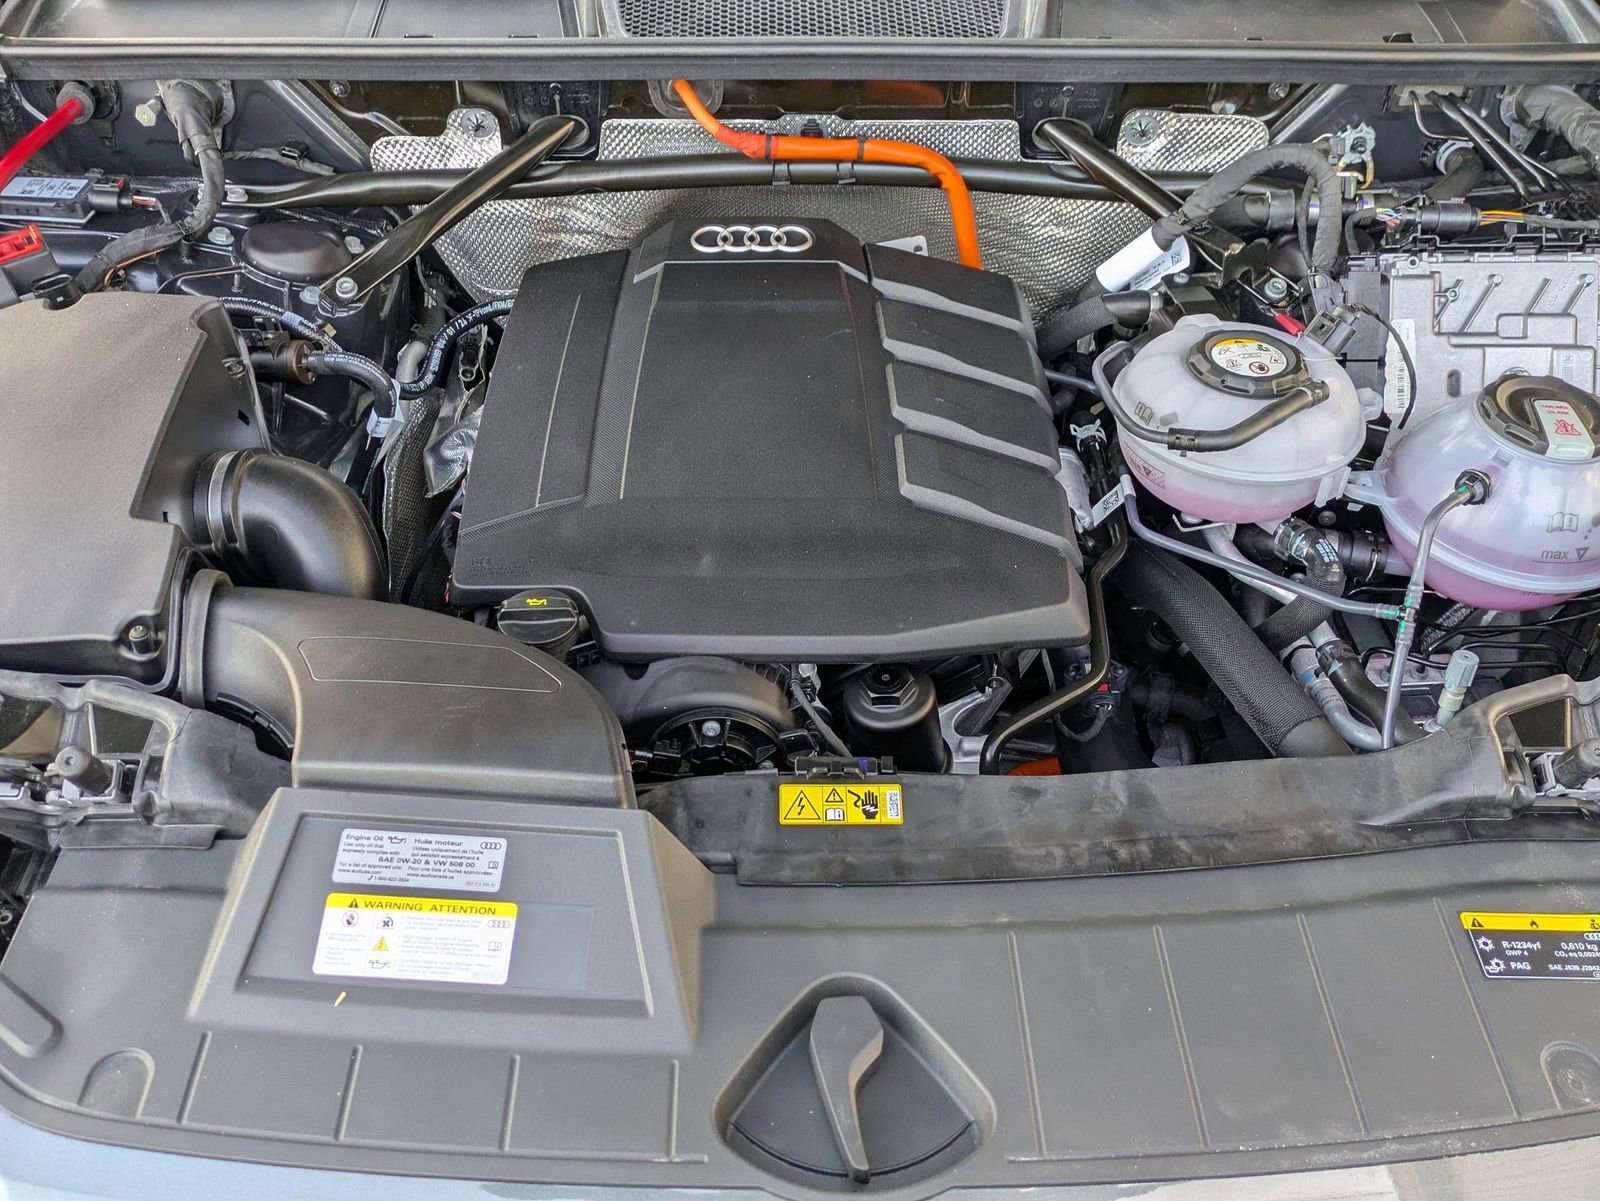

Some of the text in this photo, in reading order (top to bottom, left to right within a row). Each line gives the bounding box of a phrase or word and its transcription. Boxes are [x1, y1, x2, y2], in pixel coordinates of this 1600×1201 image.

[1541, 549, 1568, 560] max
[435, 839, 463, 847] moteur
[364, 900, 497, 915] WARNING ATTENTION
[1501, 941, 1541, 951] R-1234yf
[1560, 942, 1598, 952] 0,610 kg
[1510, 962, 1531, 970] PAG
